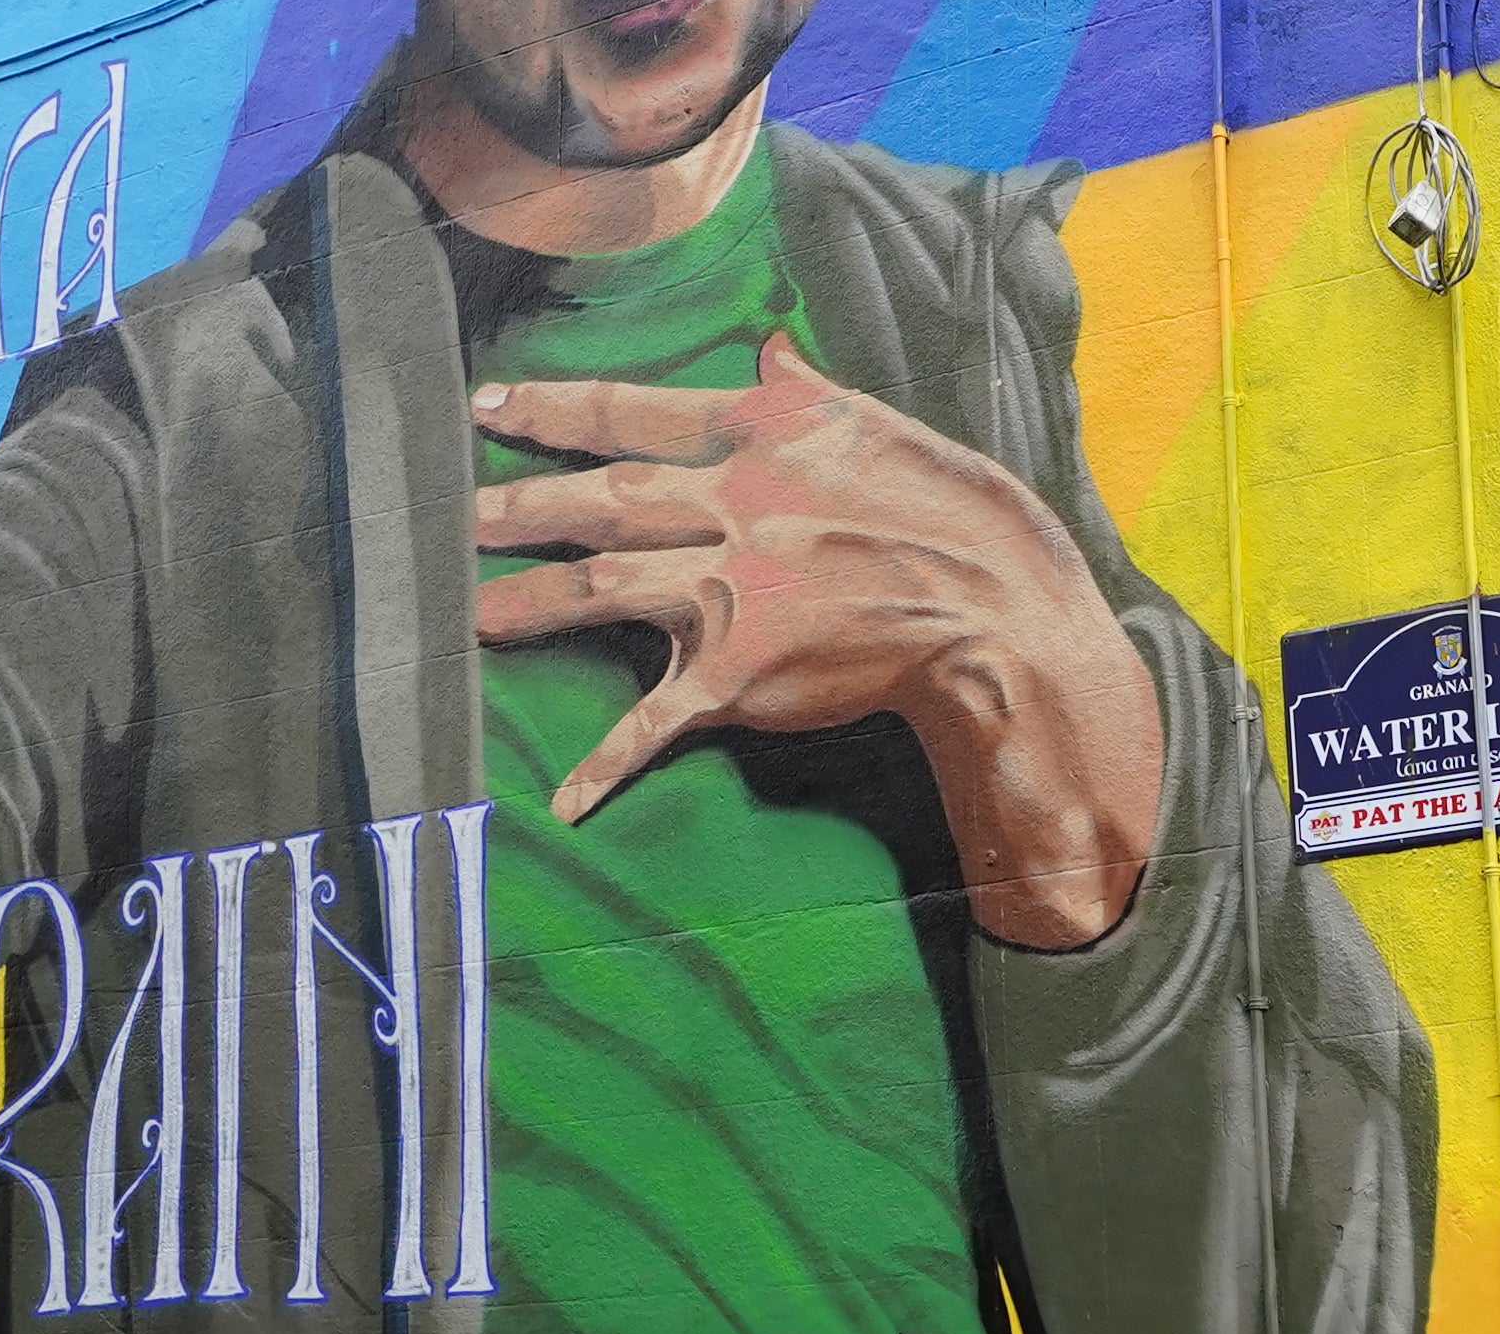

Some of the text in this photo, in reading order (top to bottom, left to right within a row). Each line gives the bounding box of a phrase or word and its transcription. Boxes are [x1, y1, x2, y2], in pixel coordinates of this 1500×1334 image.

[1308, 709, 1474, 767] WATER
[1442, 755, 1466, 771] an
[1311, 815, 1342, 829] PAT
[1353, 803, 1404, 829] PAT
[1413, 794, 1467, 819] THE
